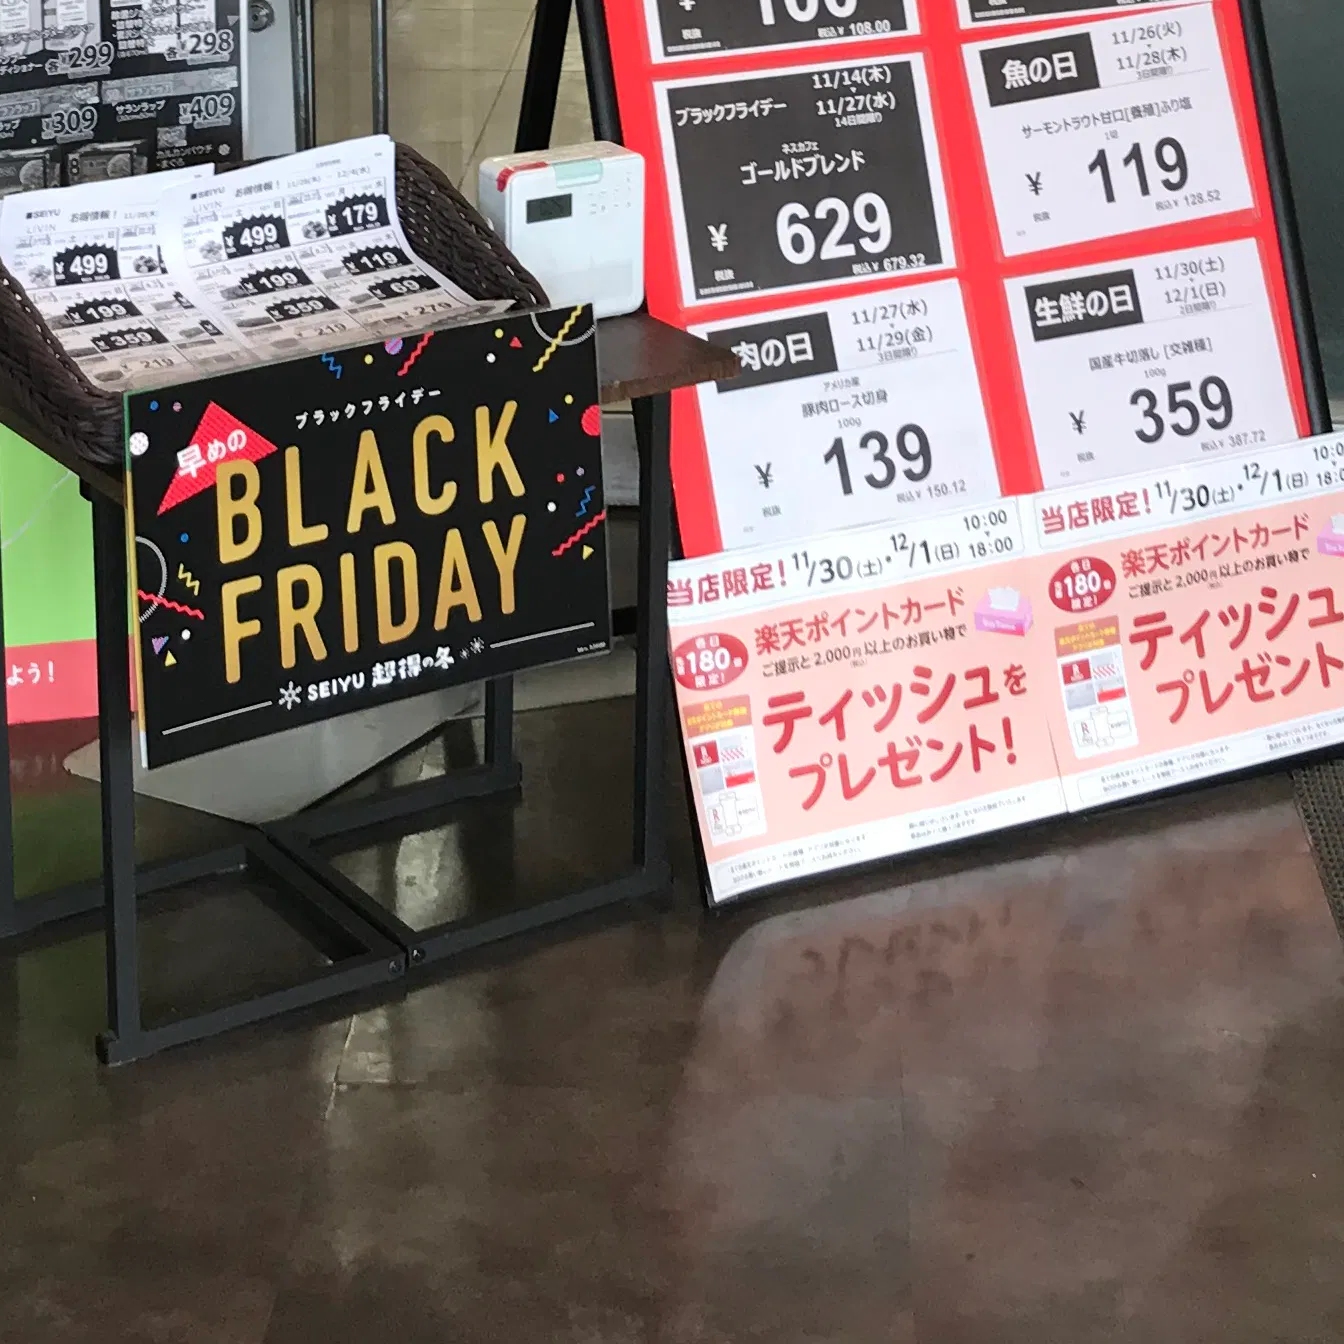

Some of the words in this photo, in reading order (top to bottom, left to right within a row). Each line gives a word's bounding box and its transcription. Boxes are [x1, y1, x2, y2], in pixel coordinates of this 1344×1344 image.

[848, 19, 891, 36] 108.00
[1112, 21, 1182, 46] 11/26(火)
[1002, 51, 1079, 90] 魚の日
[1116, 46, 1188, 71] 11/28(木)
[812, 66, 892, 90] 11/14(木)
[675, 97, 787, 126] ブラックフライデー
[816, 92, 896, 116] 11/27(水)
[739, 150, 866, 185] ゴールドブレンド
[1088, 136, 1189, 204] 119
[1183, 189, 1221, 208] 128.52
[776, 192, 893, 265] 629
[883, 253, 926, 272] 679.32
[1154, 256, 1226, 281] 11/30(土)
[1034, 284, 1135, 328] 生鮮の日
[1164, 281, 1226, 304] 12/1(日)
[851, 299, 928, 326] 11/27(水)
[731, 331, 814, 372] 肉の日
[856, 325, 933, 352] 11/29(金)
[295, 385, 441, 430] ブラックフライデー
[837, 418, 862, 429] 100g
[1130, 374, 1233, 444] 359
[176, 428, 248, 480] 早めの
[1228, 430, 1267, 448] 387.72
[823, 422, 932, 497] 139
[215, 400, 526, 565] BLACK
[926, 480, 967, 500] 150.12
[964, 509, 1007, 532] 10:00
[1041, 488, 1153, 536] 当店限定!
[969, 536, 1013, 559] 18:00
[1120, 513, 1311, 579] 楽天ポイントカード
[220, 514, 527, 685] FRIDAY
[666, 558, 787, 608] 当店限定!
[754, 587, 966, 657] 楽天ポイントカード
[307, 671, 366, 703] SEIYU
[762, 662, 1028, 754] ティッシュを
[788, 716, 1017, 811] プレゼント!
